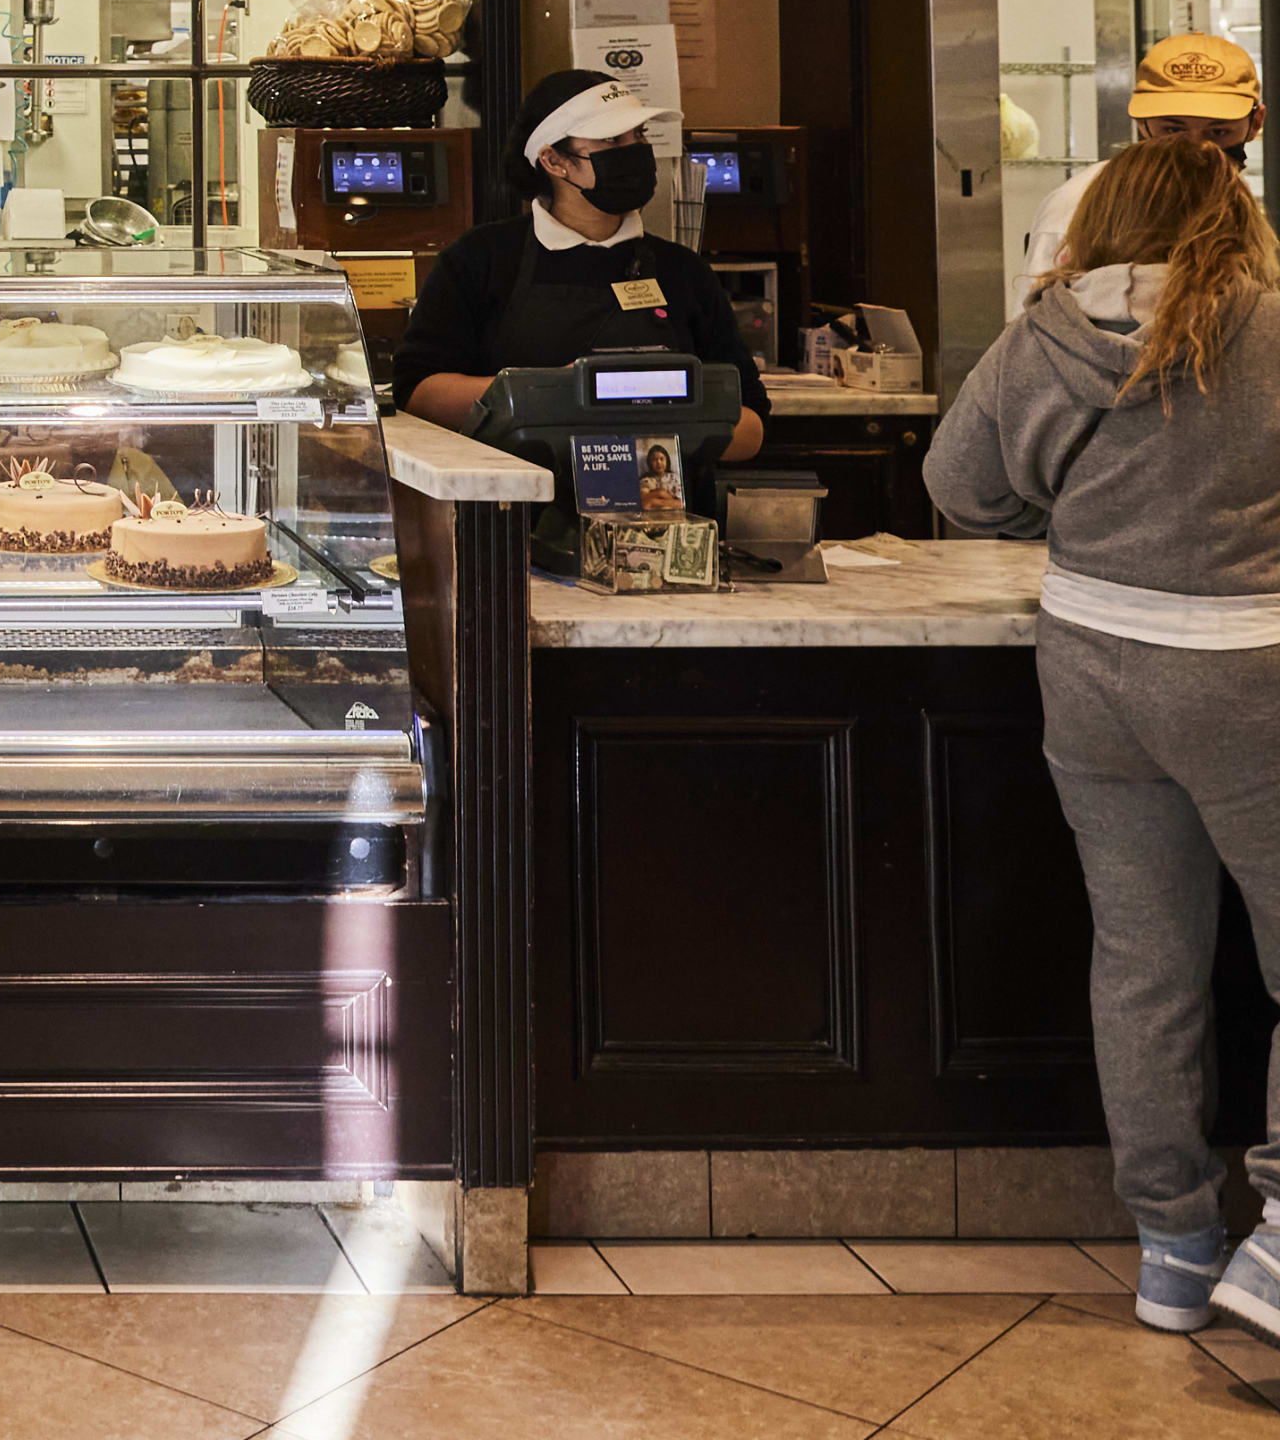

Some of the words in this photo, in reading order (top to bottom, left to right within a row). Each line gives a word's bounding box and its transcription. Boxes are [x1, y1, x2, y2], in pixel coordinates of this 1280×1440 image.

[45, 56, 85, 65] NOTICE
[581, 445, 591, 453] BE
[593, 445, 609, 453] THE
[611, 444, 629, 452] ONE
[582, 454, 605, 462] WHO
[607, 453, 632, 461] SAVES
[583, 463, 590, 471] A
[592, 463, 610, 471] LIFE.
